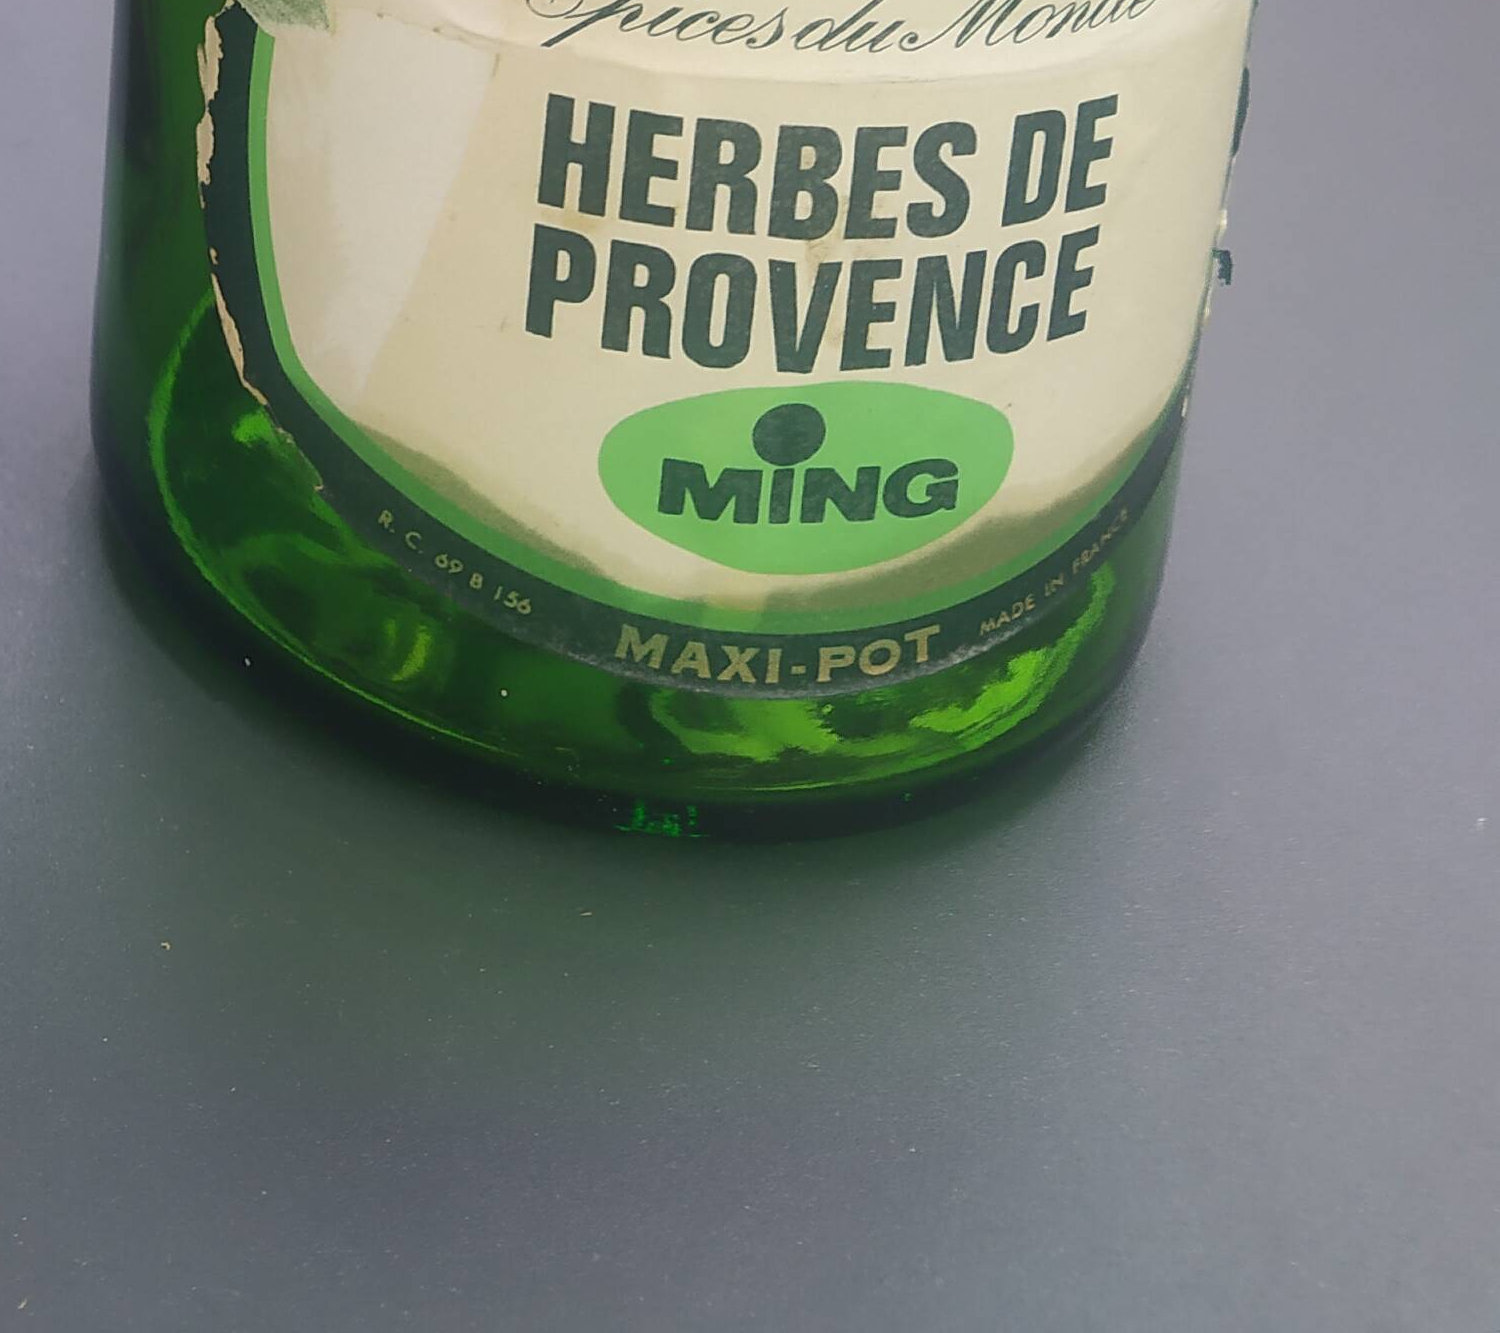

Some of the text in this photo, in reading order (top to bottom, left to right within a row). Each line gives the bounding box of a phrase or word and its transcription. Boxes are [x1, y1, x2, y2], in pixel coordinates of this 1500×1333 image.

[537, 92, 1119, 241] HERBES DE
[525, 223, 1101, 374] PROVENCE
[434, 553, 465, 575] 69
[492, 585, 533, 615] 156
[979, 593, 1036, 637] MADE
[613, 623, 941, 685] MAXI-POT
